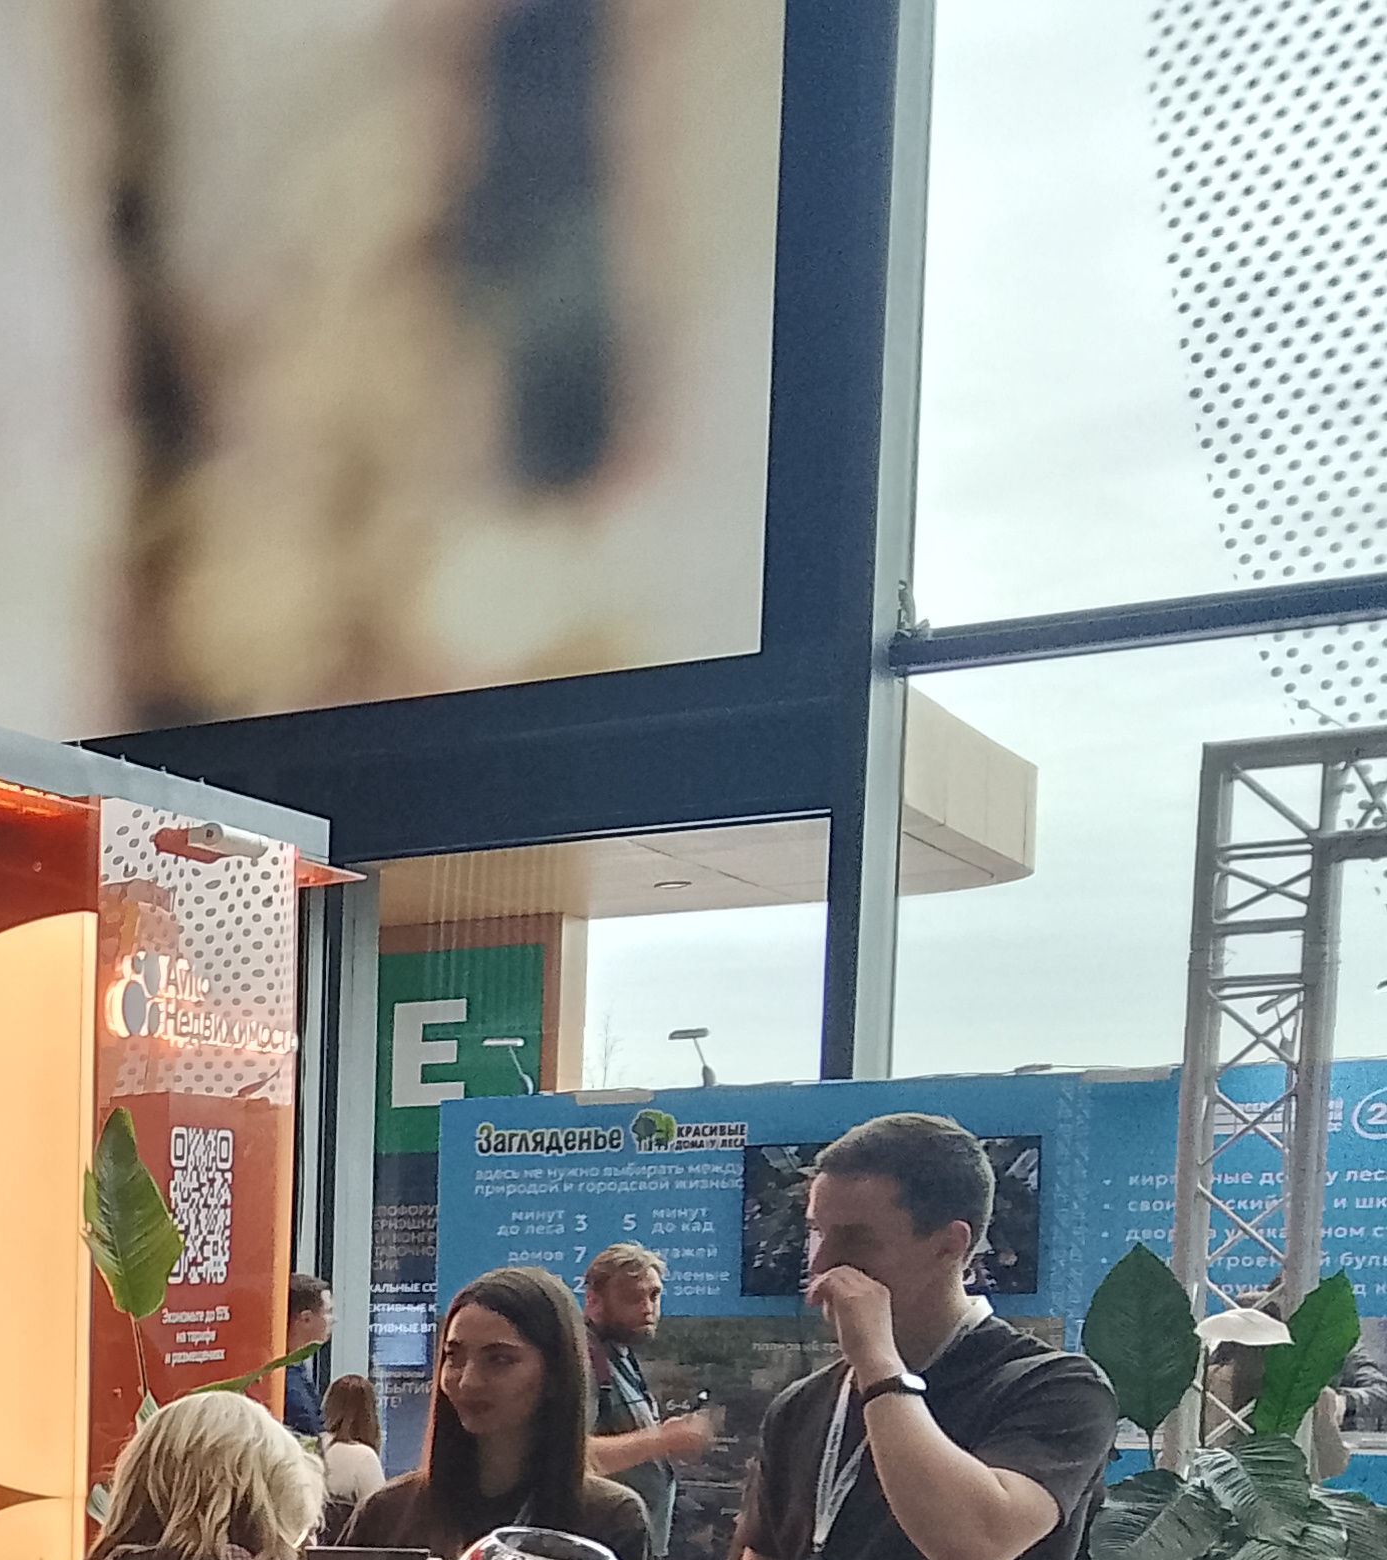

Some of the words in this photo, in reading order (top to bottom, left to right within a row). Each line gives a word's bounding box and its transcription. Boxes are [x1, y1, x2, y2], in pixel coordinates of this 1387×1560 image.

[676, 1123, 747, 1138] КРАСИВЫЕ
[477, 1123, 623, 1155] Загляденье
[674, 1138, 705, 1151] ДОМА
[708, 1138, 716, 1149] У
[719, 1136, 746, 1149] ЛЕСА
[523, 1168, 544, 1179] не
[547, 1166, 600, 1183] нужно
[603, 1161, 685, 1178] выбирать
[474, 1182, 559, 1198] природой
[563, 1182, 574, 1193] и
[1333, 1198, 1347, 1209] и
[510, 1209, 566, 1223] минут
[652, 1206, 709, 1221] минут
[496, 1224, 521, 1237] до
[525, 1222, 566, 1236] леса
[574, 1213, 588, 1232] 3
[622, 1213, 637, 1232] 5
[650, 1221, 677, 1236] до
[507, 1250, 565, 1263] домов
[573, 1245, 587, 1264] 7
[662, 1269, 731, 1283] еленые
[369, 1282, 421, 1294] КАЛЬНЫЕ
[369, 1302, 427, 1313] ЕКТИВНЫЕ
